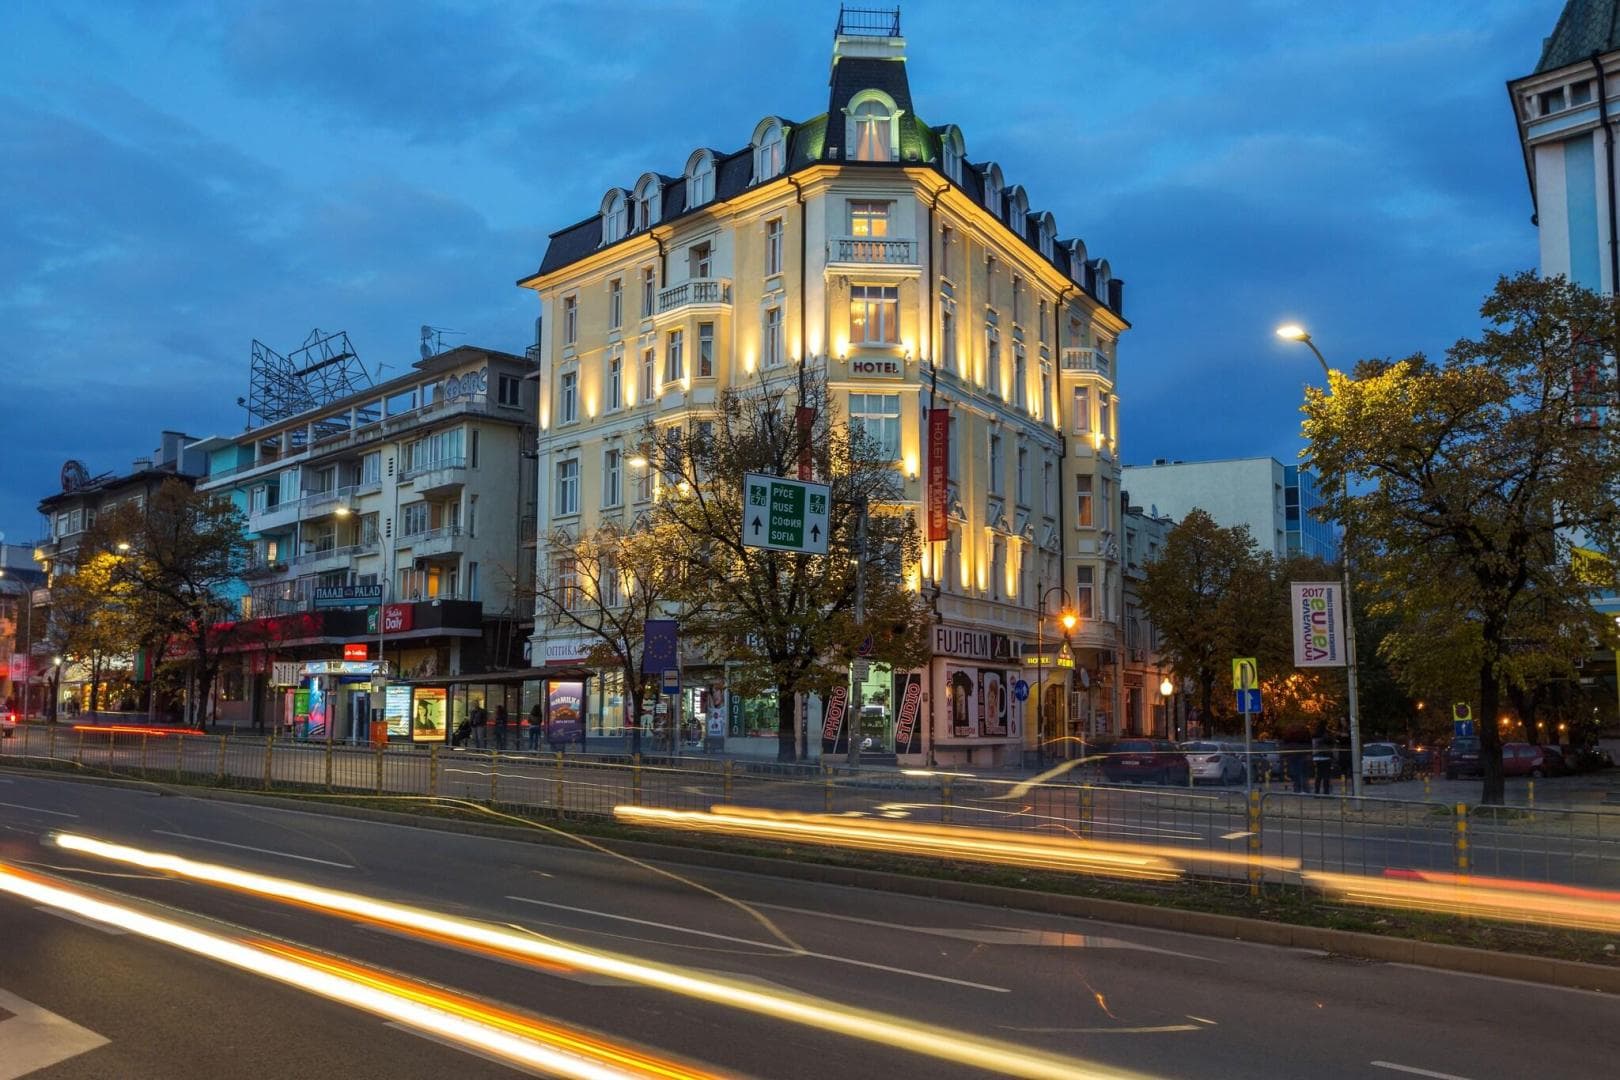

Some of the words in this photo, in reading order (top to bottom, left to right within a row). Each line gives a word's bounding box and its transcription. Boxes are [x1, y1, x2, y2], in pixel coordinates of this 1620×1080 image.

[853, 361, 899, 374] HOTEL
[756, 486, 762, 496] 2
[773, 487, 794, 499] РУСЕ
[751, 496, 766, 506] E70
[815, 495, 821, 503] 2
[772, 502, 794, 513] RUSE
[810, 503, 825, 514] E70
[772, 516, 801, 529] СОФИЯ
[771, 530, 794, 542] SOFIA
[354, 586, 381, 598] PALAD
[1302, 587, 1325, 598] 2017
[385, 617, 403, 630] Daily
[936, 628, 988, 656] FUJIFILM
[824, 685, 846, 741] PHOTO
[897, 682, 921, 744] STUDIO
